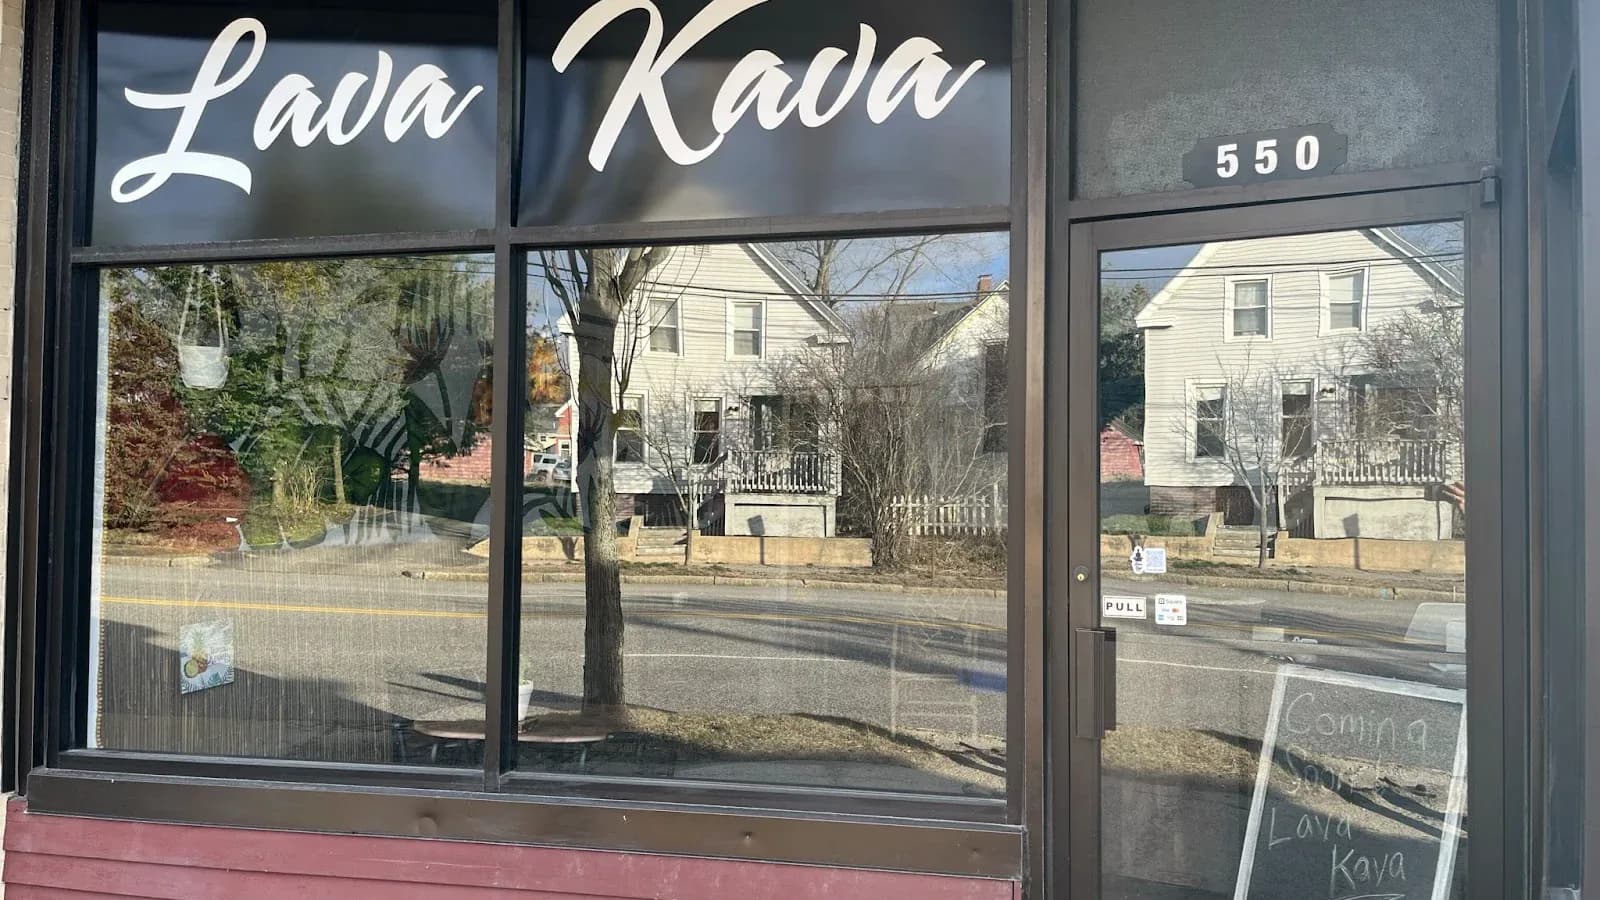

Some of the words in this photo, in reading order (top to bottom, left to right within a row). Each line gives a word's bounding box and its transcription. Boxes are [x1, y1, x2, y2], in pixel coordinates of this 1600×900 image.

[111, 17, 484, 203] Lava
[552, 0, 986, 172] Kava
[1216, 135, 1320, 178] 550
[1105, 601, 1144, 613] PULL
[1268, 807, 1352, 850] Lava
[1330, 843, 1407, 898] Kava
